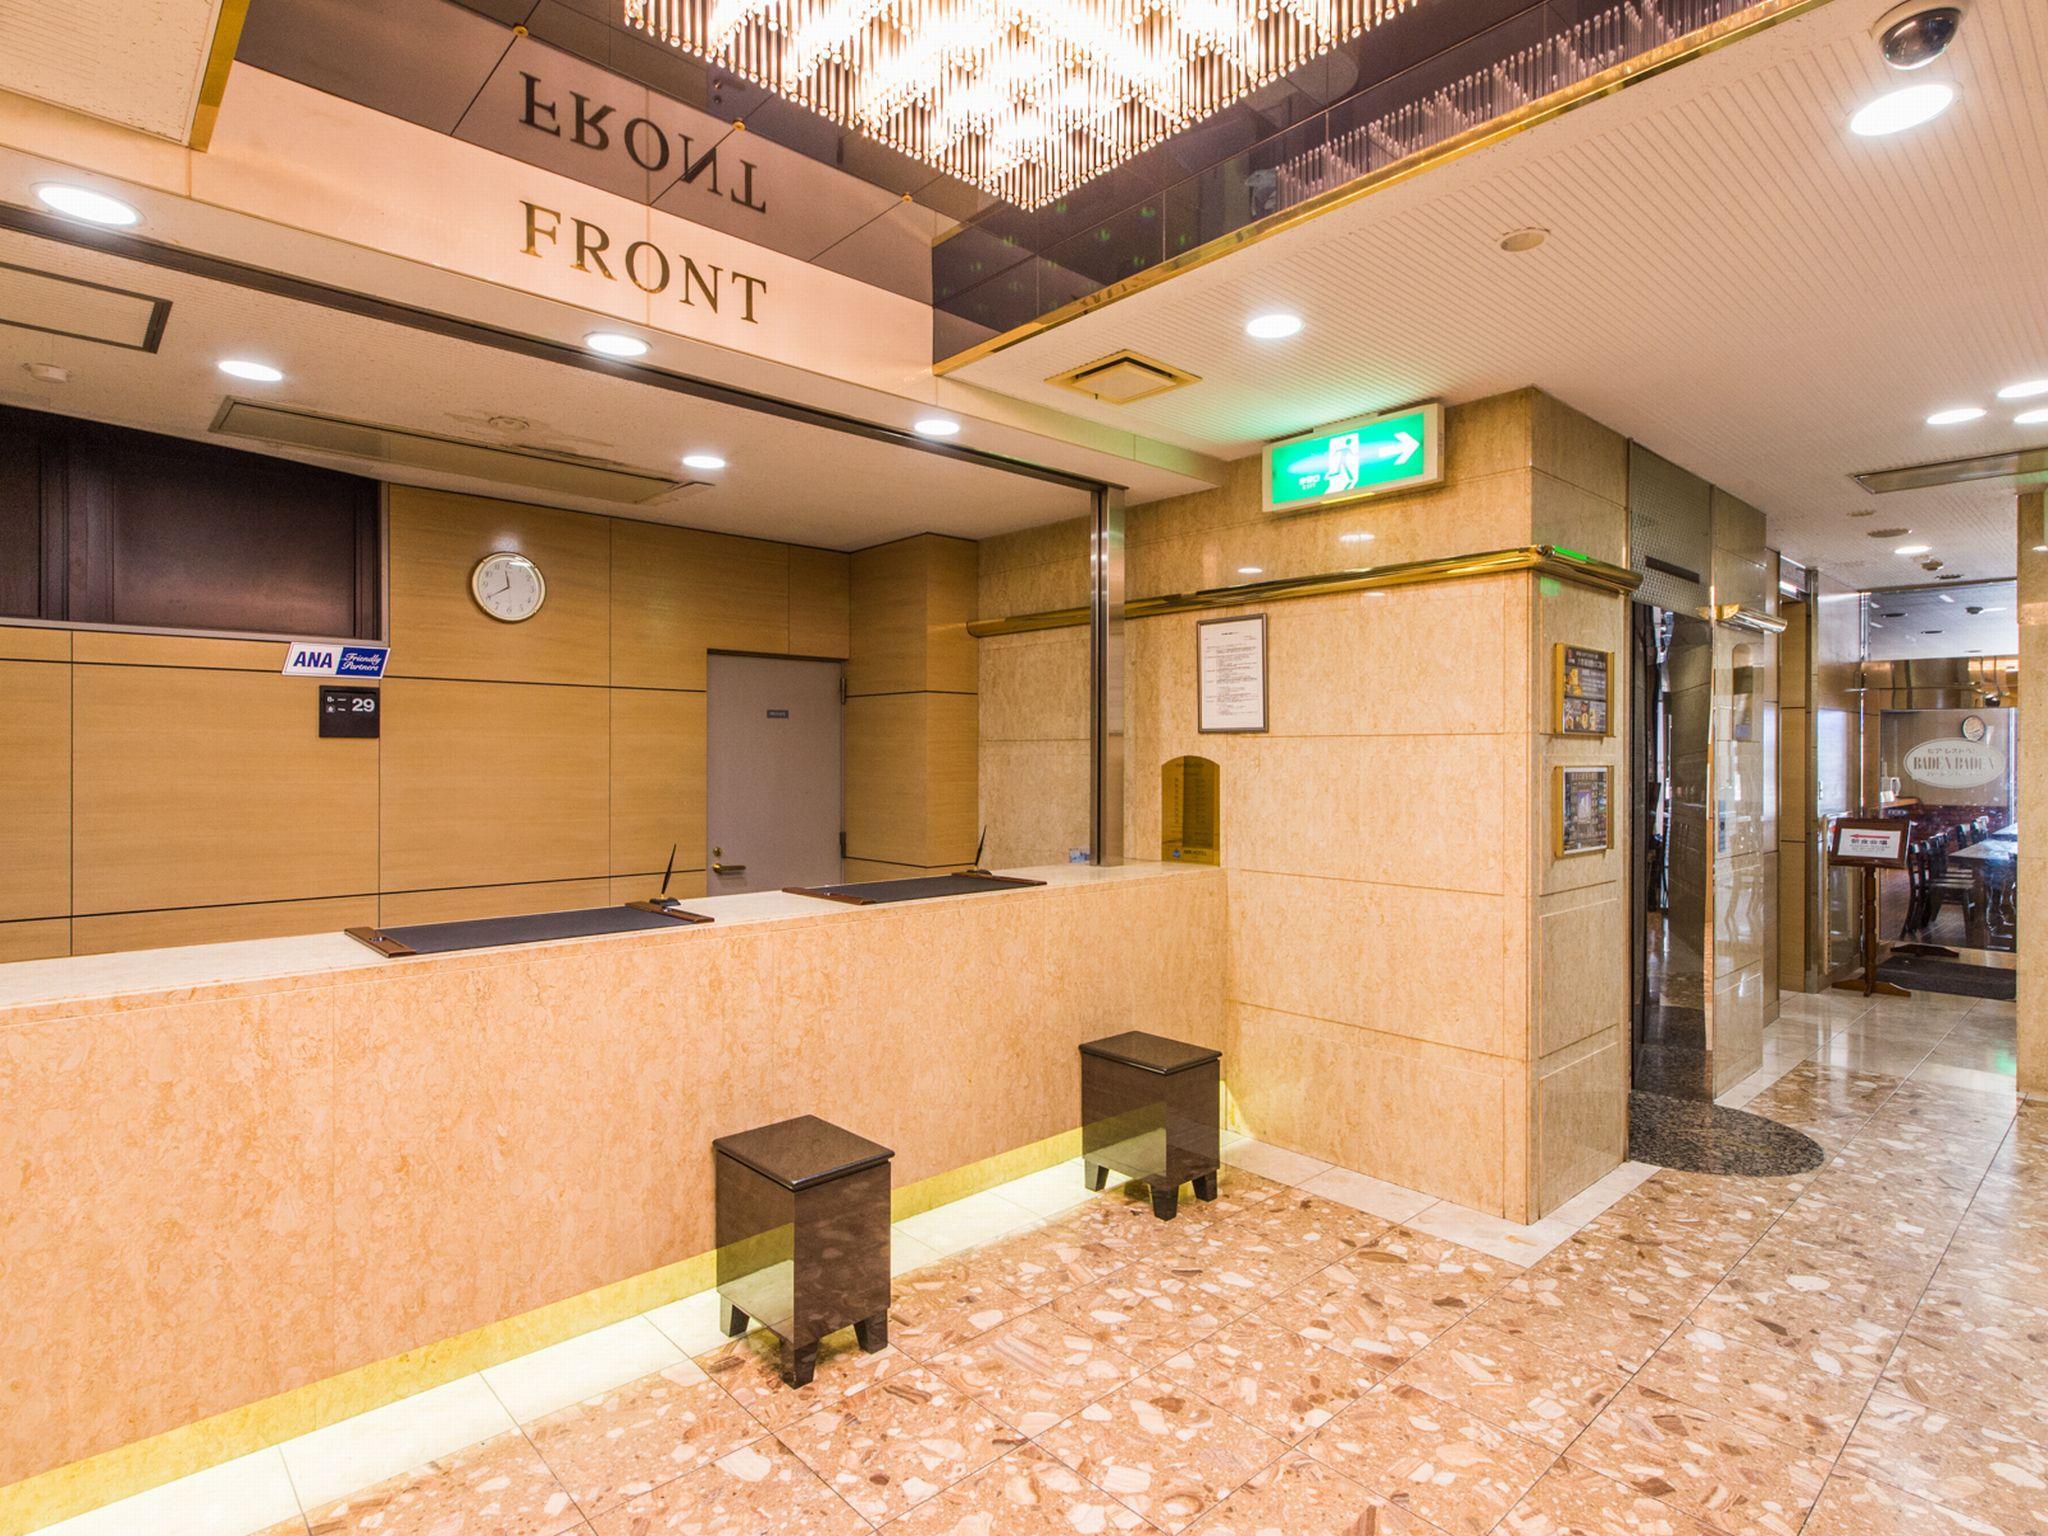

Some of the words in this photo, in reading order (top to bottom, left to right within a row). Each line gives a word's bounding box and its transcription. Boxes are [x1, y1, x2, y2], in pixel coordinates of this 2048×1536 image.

[519, 200, 767, 324] FRONT
[293, 651, 332, 668] ANA
[341, 661, 379, 671] Partners
[344, 653, 382, 665] Friendly
[352, 698, 375, 712] 29
